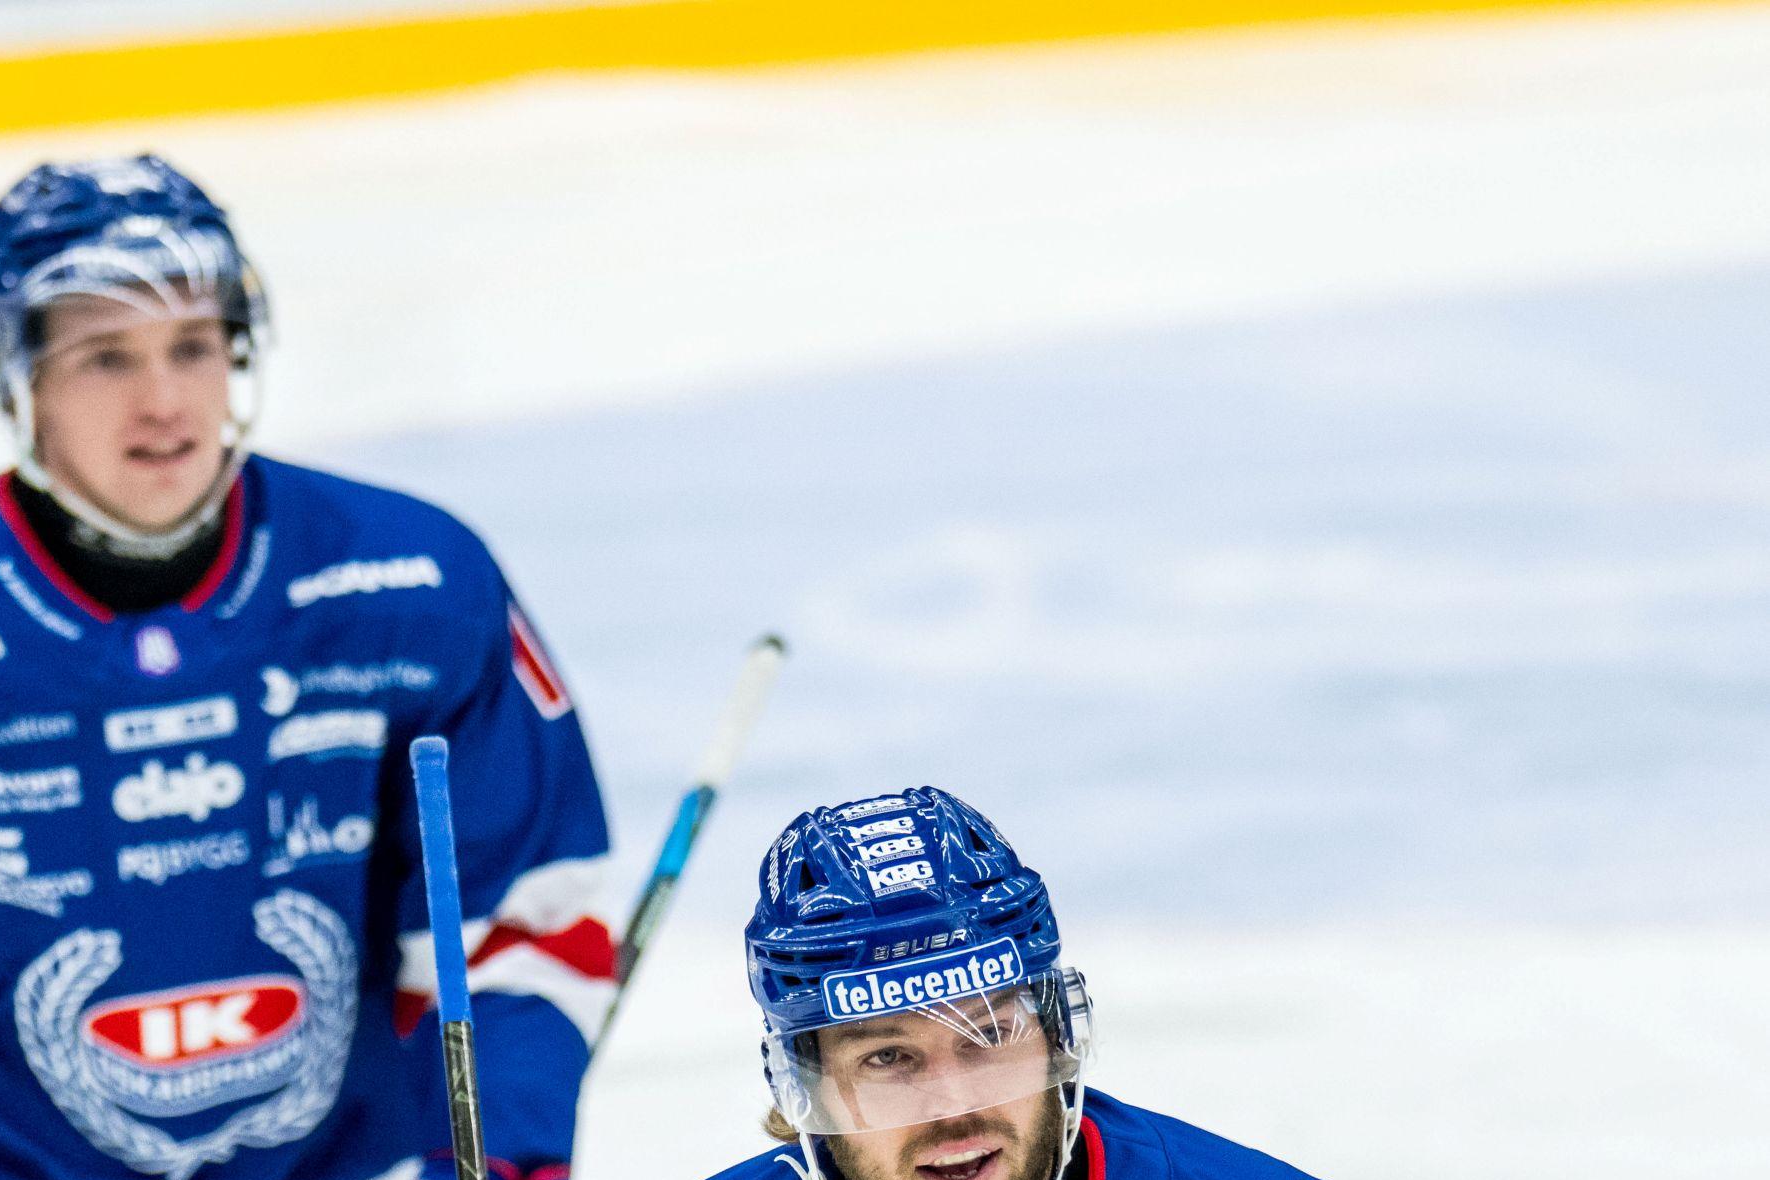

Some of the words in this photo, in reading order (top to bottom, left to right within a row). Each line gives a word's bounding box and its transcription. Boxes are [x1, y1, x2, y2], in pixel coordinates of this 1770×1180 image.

[111, 752, 246, 822] elajo
[857, 836, 924, 860] KBG
[867, 861, 933, 891] KBG
[834, 951, 1014, 1014] telecenter
[139, 991, 258, 1060] IK
